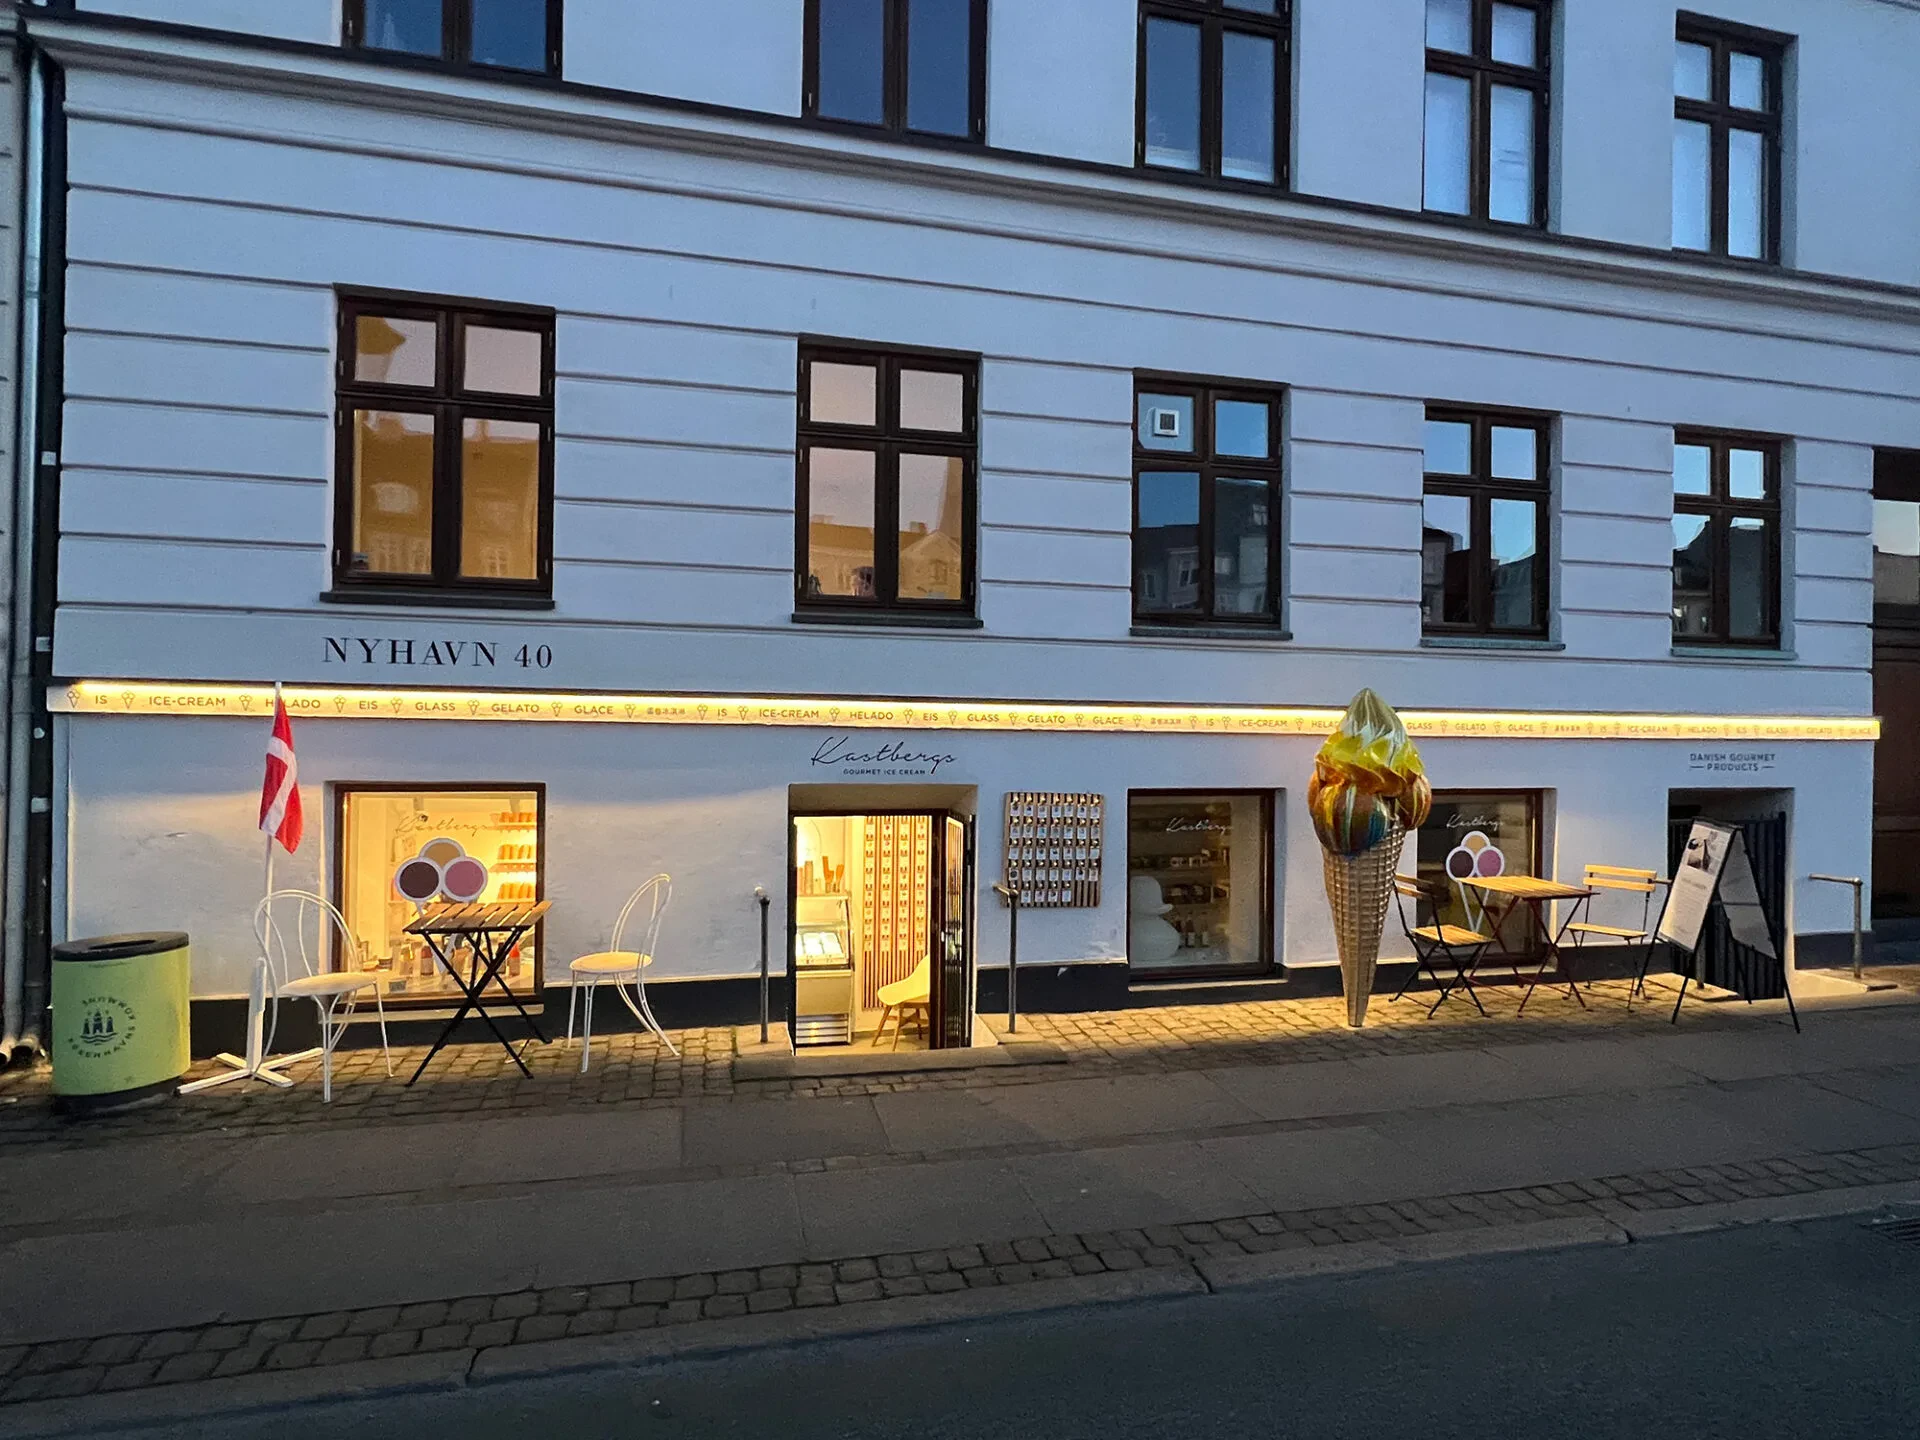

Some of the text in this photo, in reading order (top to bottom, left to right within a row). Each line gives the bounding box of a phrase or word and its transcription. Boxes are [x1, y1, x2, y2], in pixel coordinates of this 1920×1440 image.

[322, 636, 553, 669] NYHAVN 40
[95, 695, 108, 705] IS
[149, 696, 226, 707] ICE-CREAM
[265, 697, 321, 709] HLADO
[359, 700, 378, 710] EIS
[415, 701, 456, 711] GLASS
[491, 703, 540, 714] GELATO
[574, 705, 614, 715] GLACE
[717, 708, 728, 717] IS
[759, 708, 819, 719] ICE-CREAM
[850, 711, 894, 721] HELADO
[923, 712, 939, 721] EIS
[967, 713, 1000, 723] GLASS
[1027, 714, 1066, 724] GELATO
[1092, 716, 1124, 725] GLACE
[1206, 718, 1214, 727] IS
[1238, 718, 1288, 728] ICE-CREAM
[1406, 722, 1432, 730] GLASS
[1455, 723, 1486, 731] GELATO
[1508, 723, 1535, 732] GLACE
[811, 736, 957, 775] Kastbergs
[1690, 753, 1776, 762] DANISH GOURMET
[843, 768, 881, 776] GOURMET
[884, 768, 896, 776] ICE
[1707, 763, 1759, 771] PRODUCTS
